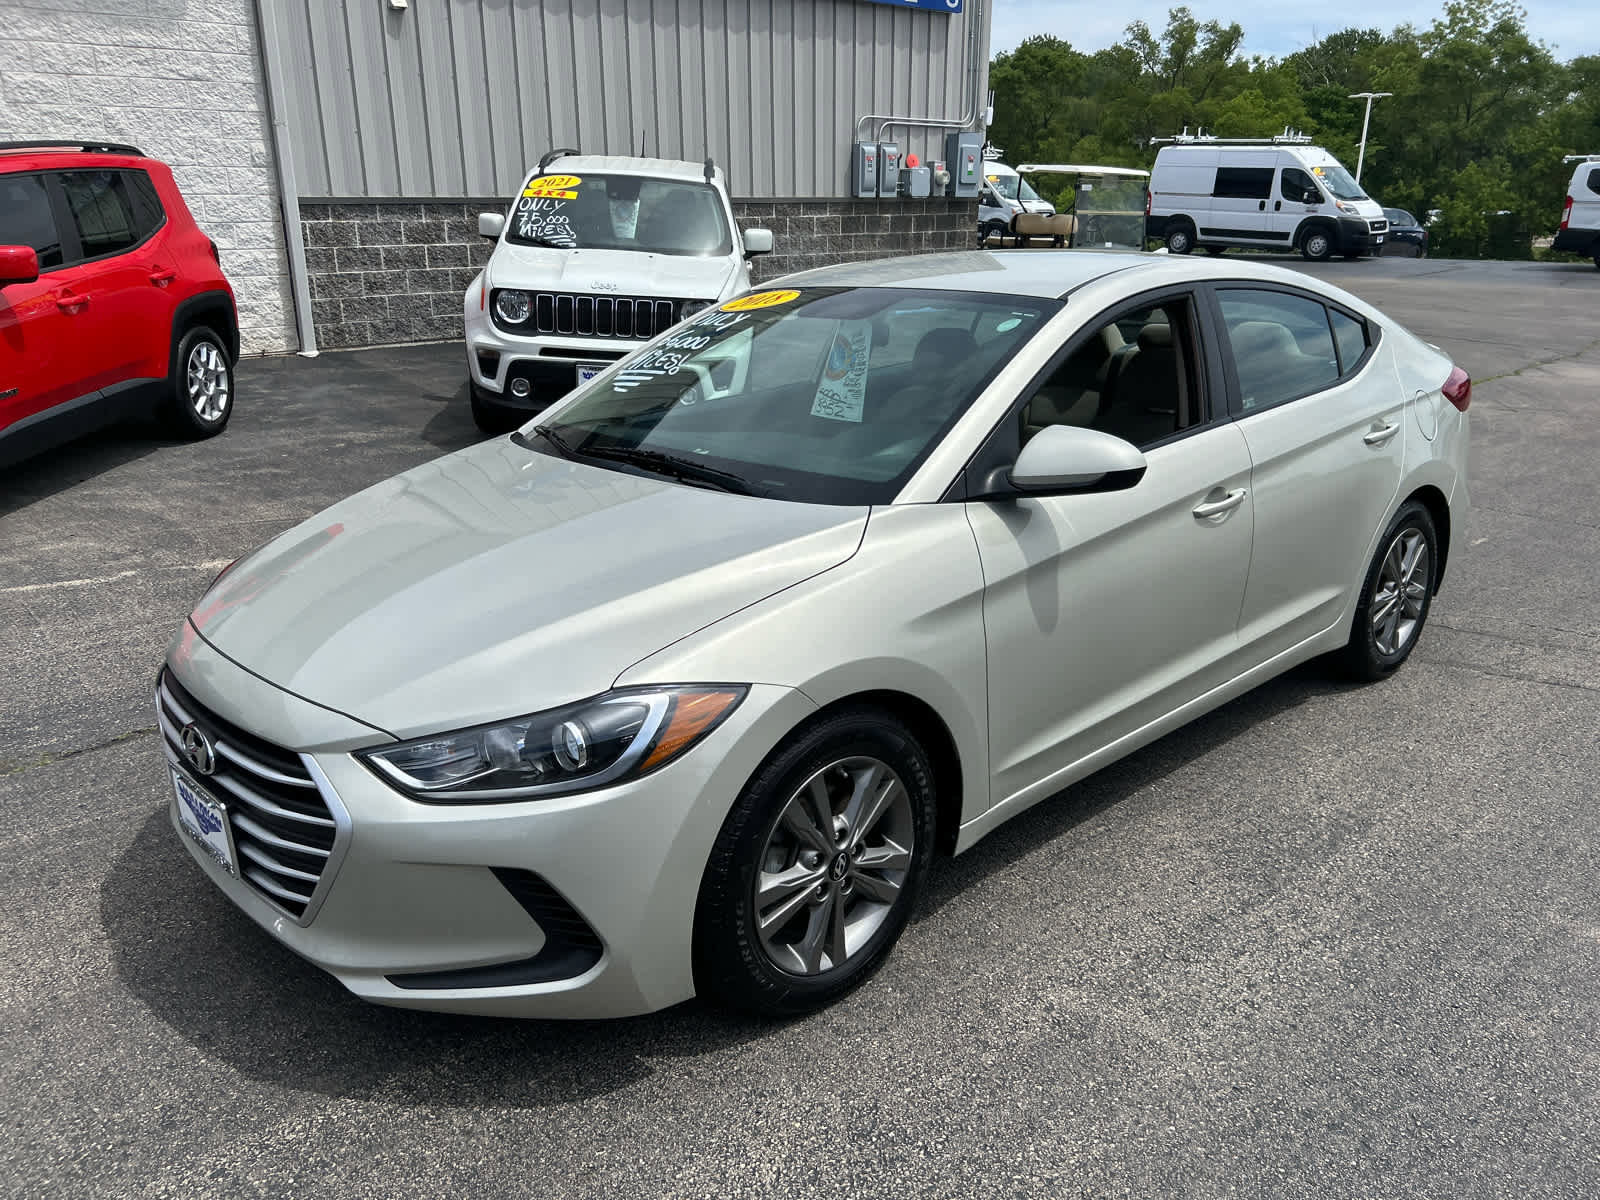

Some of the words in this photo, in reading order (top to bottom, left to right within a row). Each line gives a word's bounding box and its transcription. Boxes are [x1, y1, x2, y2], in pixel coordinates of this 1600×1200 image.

[536, 177, 572, 188] 2021
[519, 198, 566, 214] ONLY
[517, 212, 569, 226] 75,000
